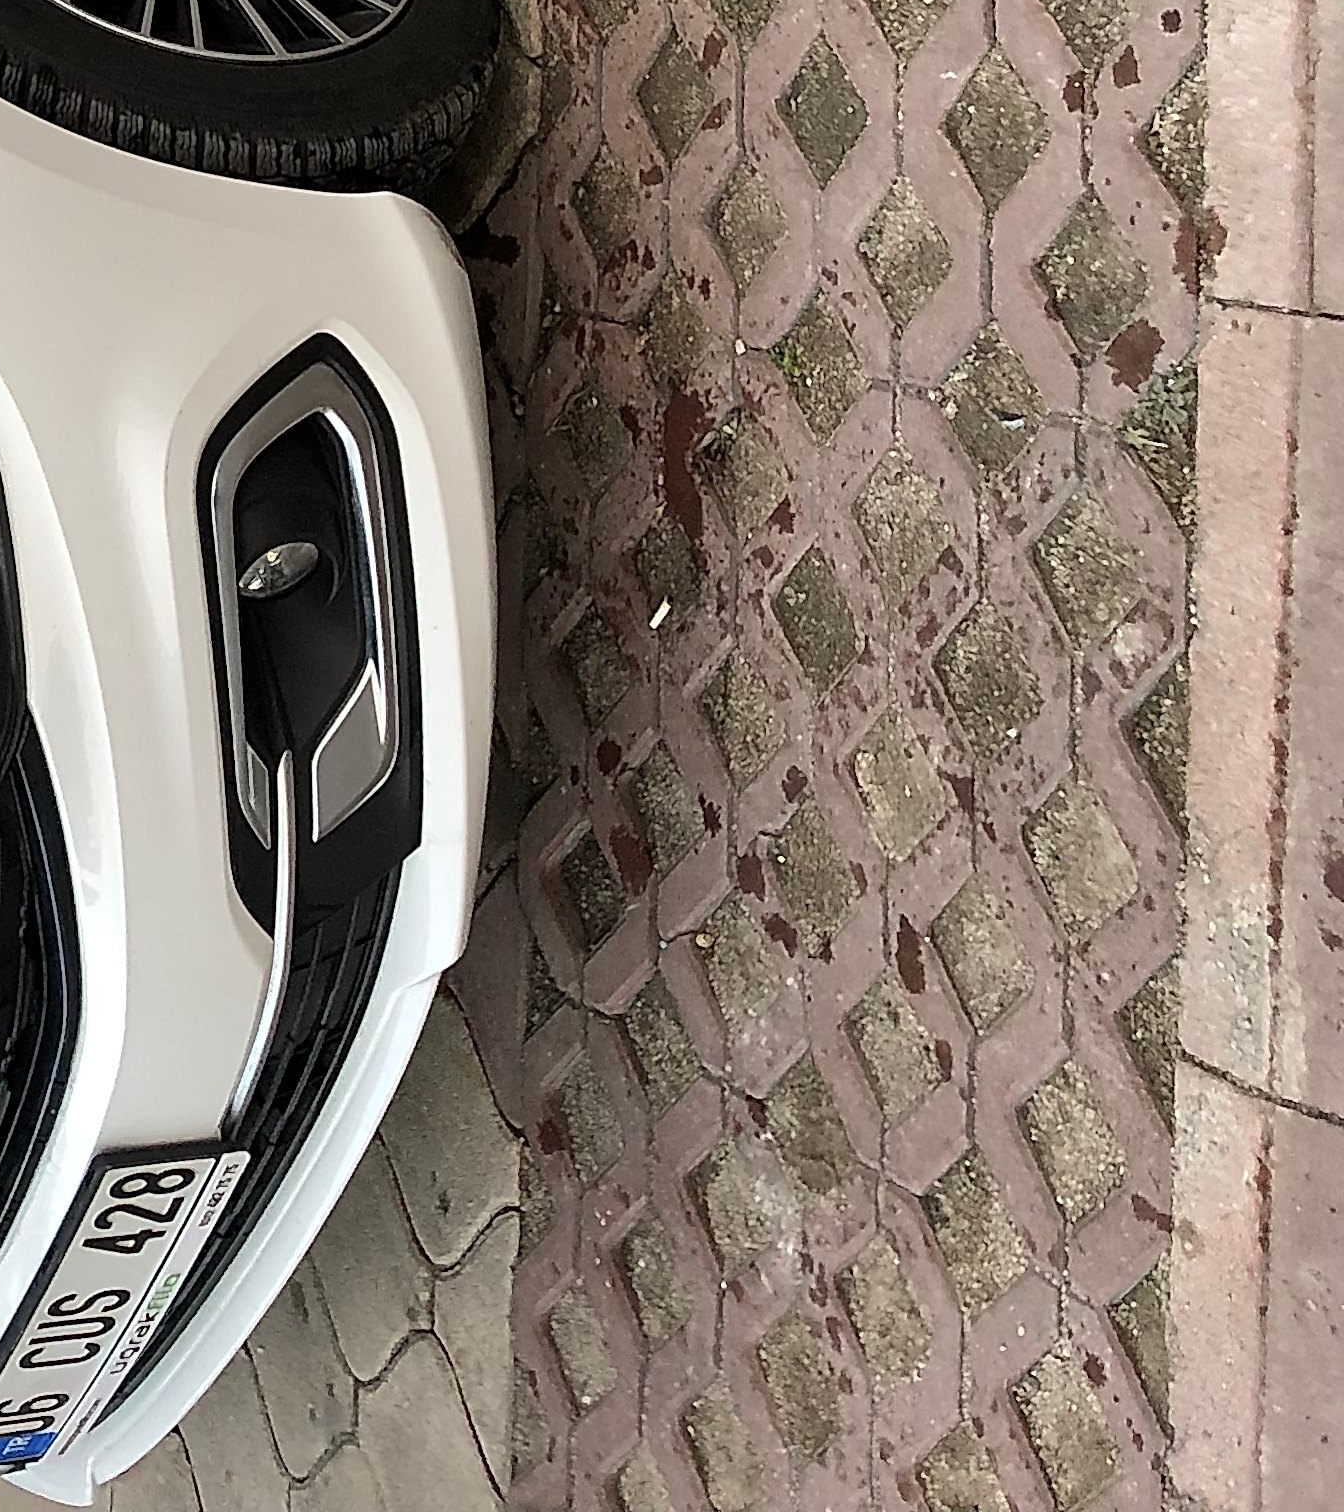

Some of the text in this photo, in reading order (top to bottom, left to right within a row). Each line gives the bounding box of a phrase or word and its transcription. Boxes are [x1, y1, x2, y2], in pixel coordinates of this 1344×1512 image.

[18, 1289, 131, 1369] CUS
[81, 1168, 196, 1254] 428
[1, 1435, 33, 1456] TR
